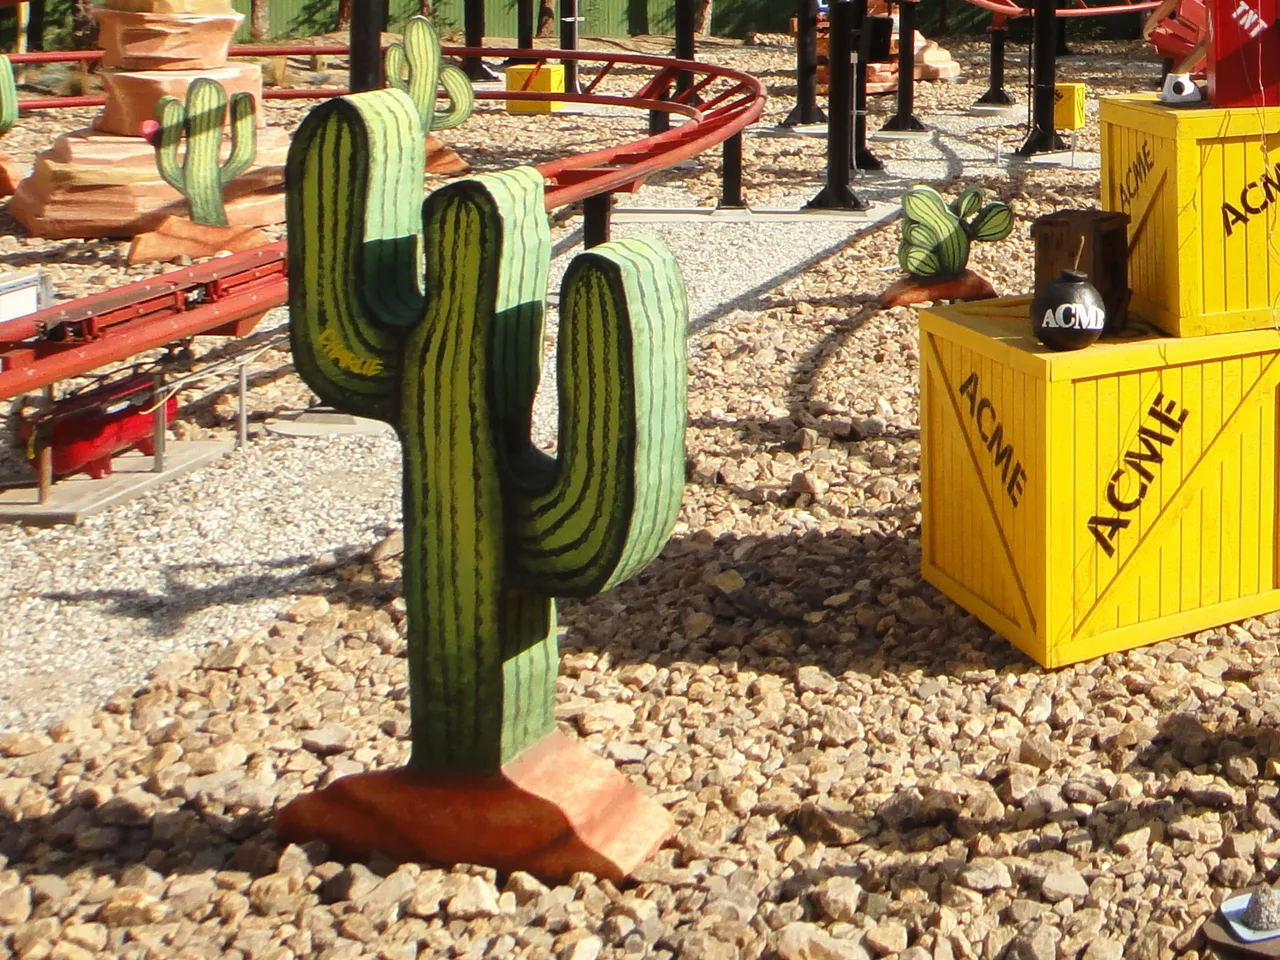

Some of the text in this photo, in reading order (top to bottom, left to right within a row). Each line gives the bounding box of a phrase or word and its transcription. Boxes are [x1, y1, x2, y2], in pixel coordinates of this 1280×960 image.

[1231, 0, 1268, 38] TNT
[1119, 140, 1155, 214] ACME
[959, 371, 1028, 509] ACME
[1087, 391, 1190, 558] ACME
